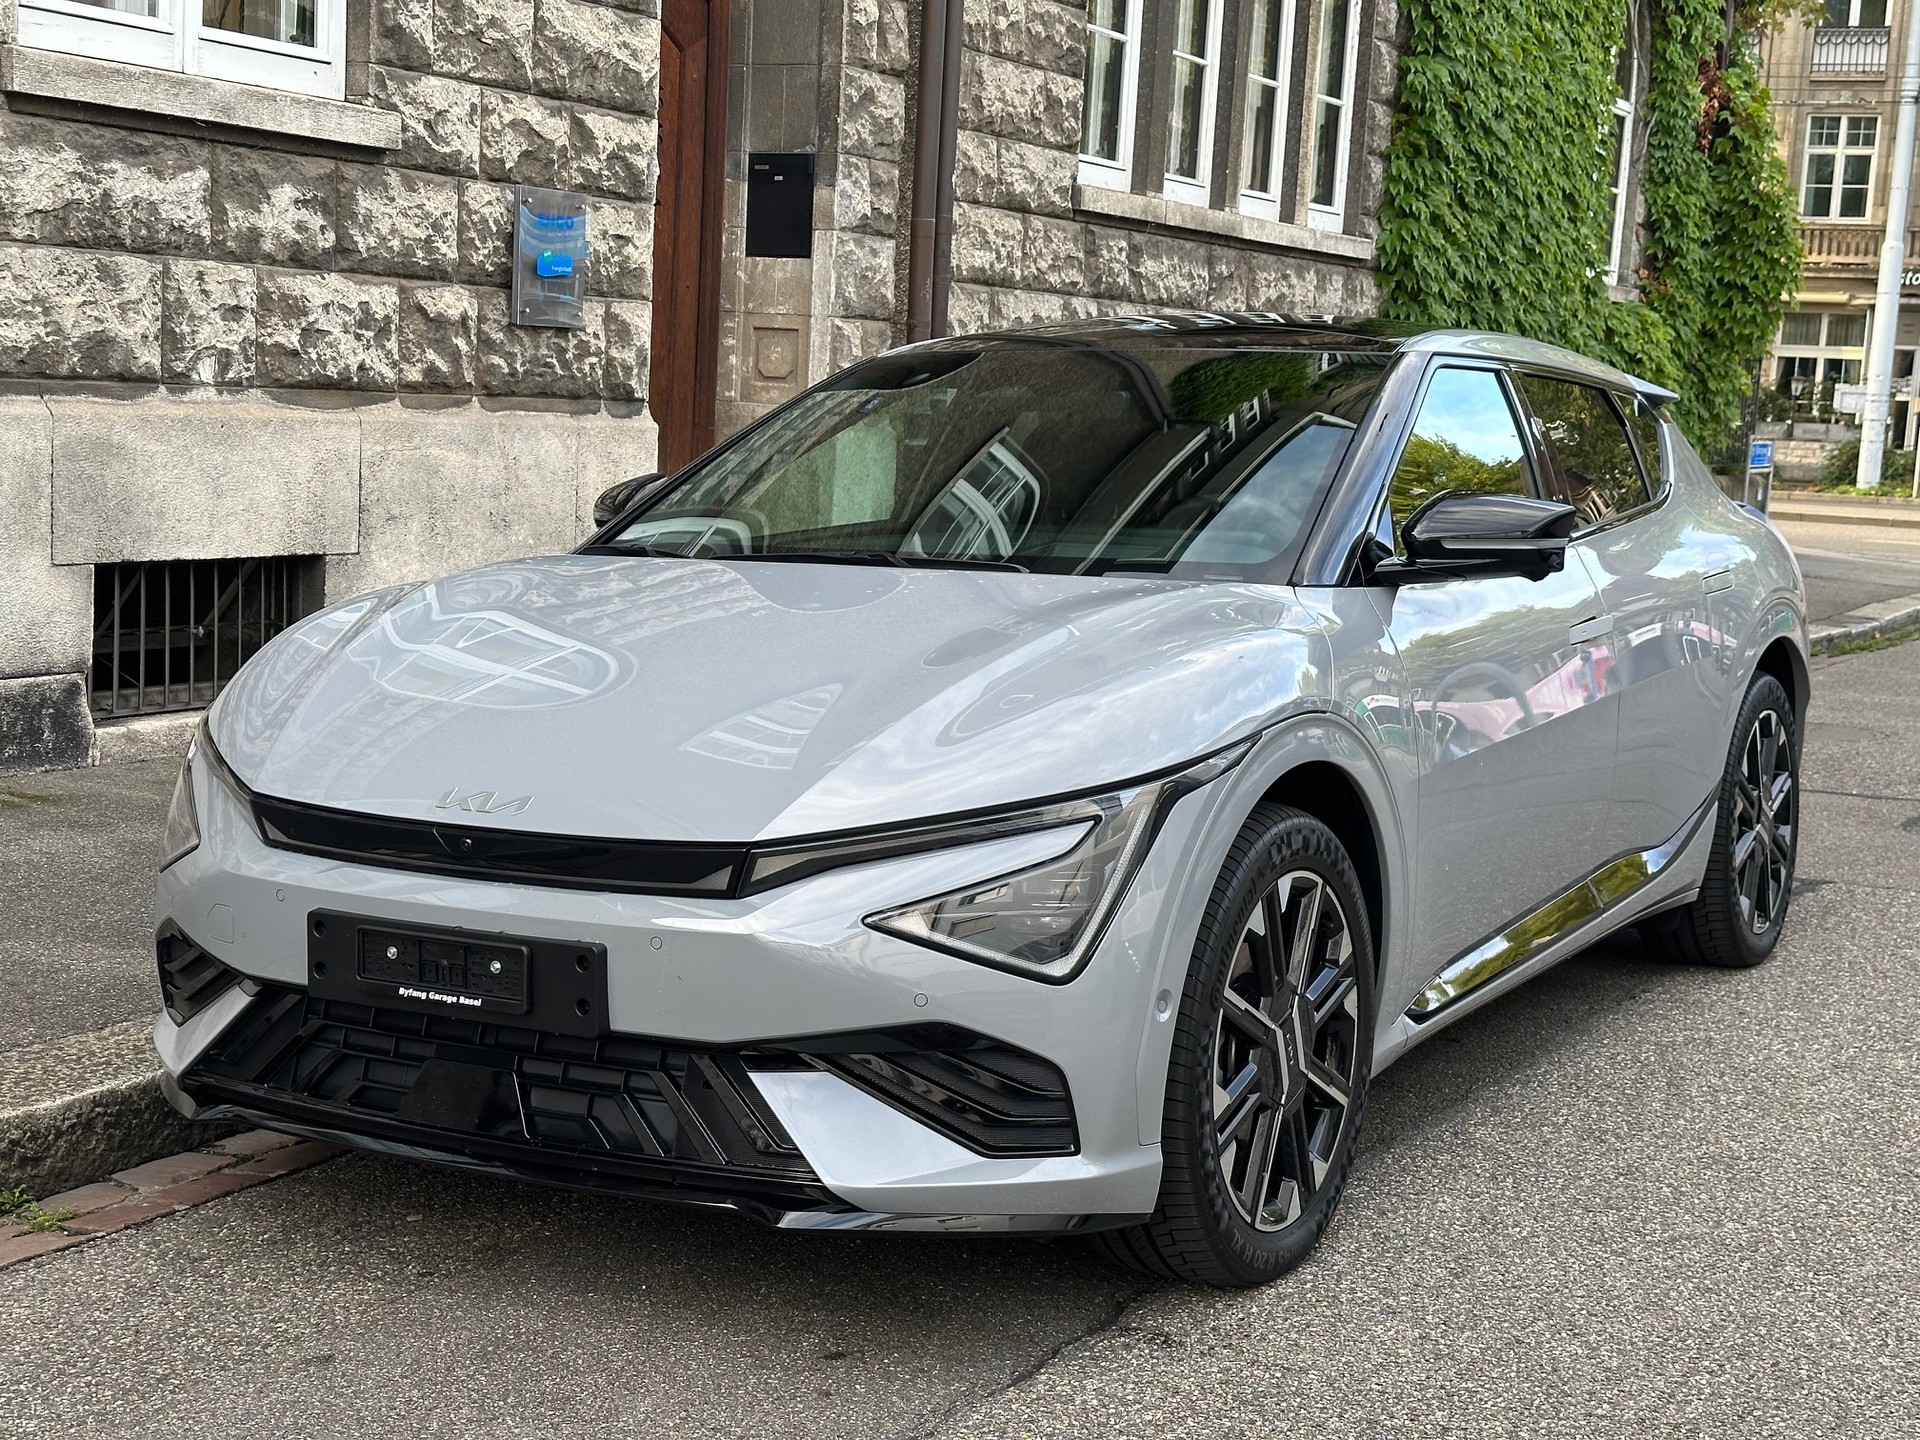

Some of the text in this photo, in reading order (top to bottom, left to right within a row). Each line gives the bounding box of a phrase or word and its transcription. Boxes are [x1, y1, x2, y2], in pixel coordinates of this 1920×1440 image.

[435, 787, 535, 816] KIA
[398, 987, 482, 1007] Byfang Garage Basel
